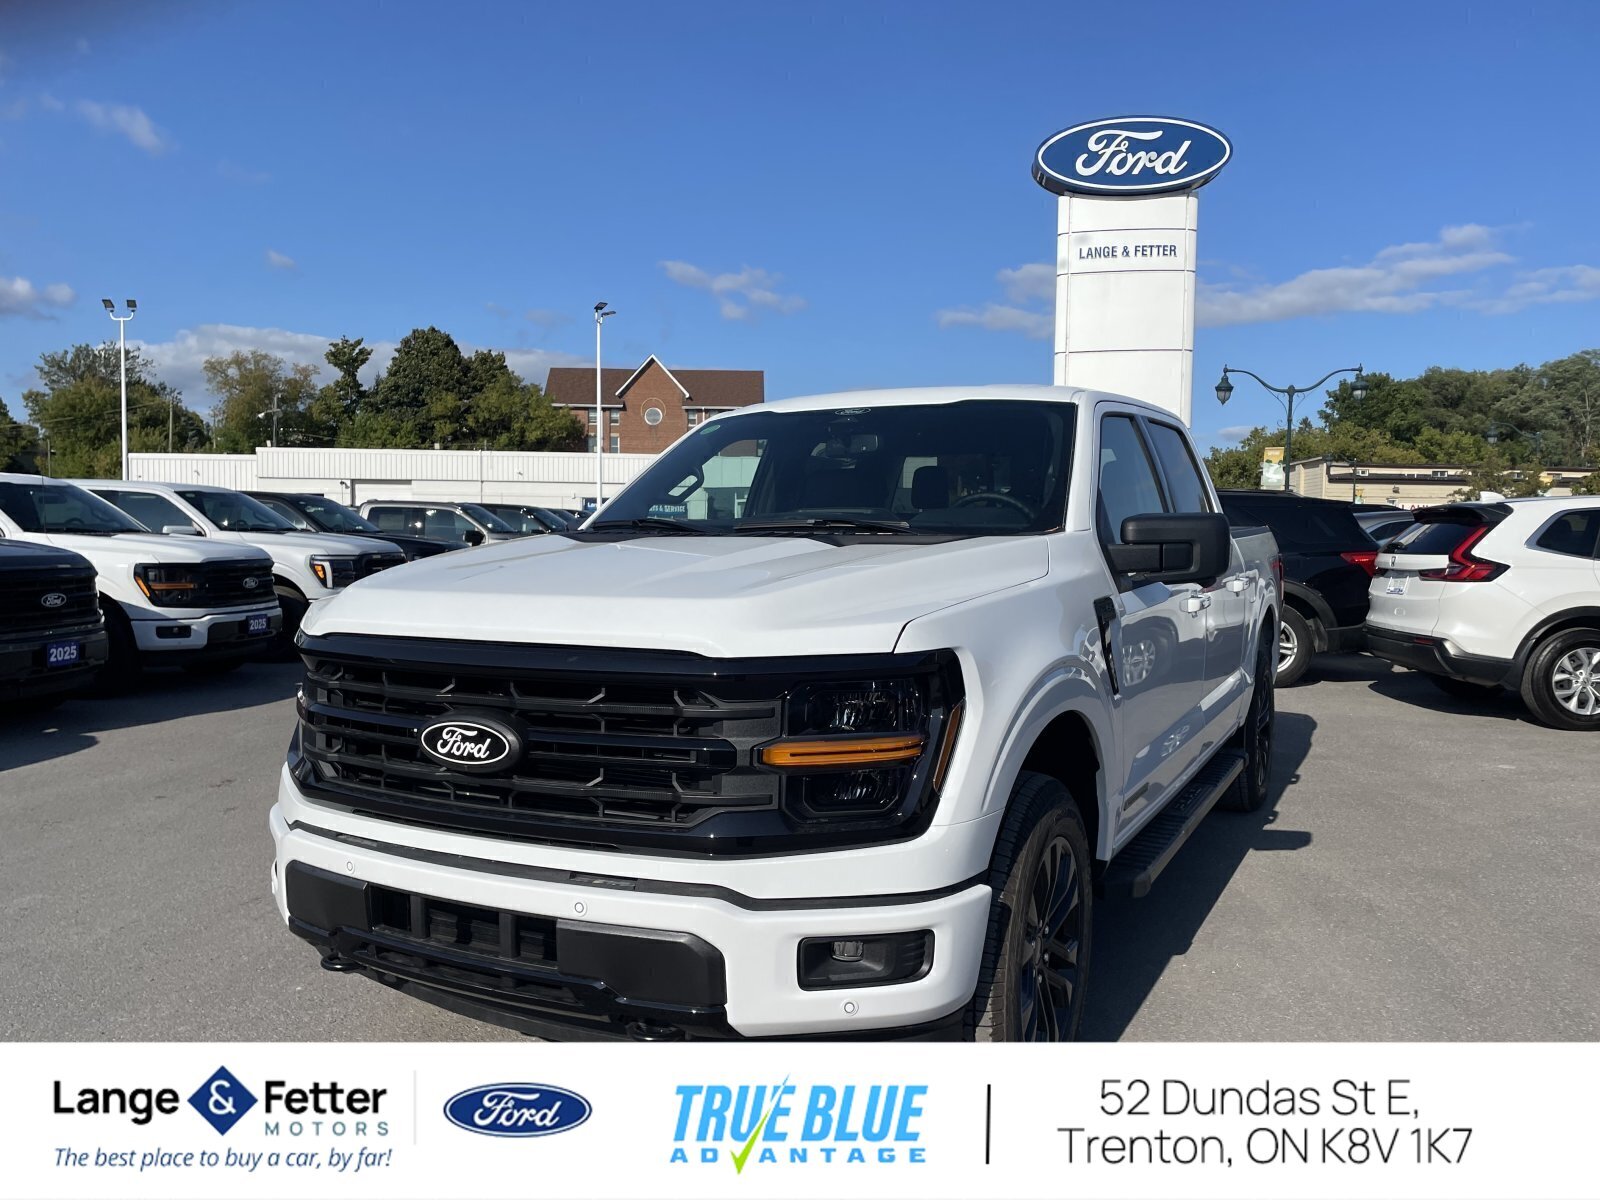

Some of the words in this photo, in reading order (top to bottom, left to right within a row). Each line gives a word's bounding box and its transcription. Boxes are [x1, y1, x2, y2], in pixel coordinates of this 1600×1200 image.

[1075, 129, 1192, 176] Ford
[1079, 246, 1118, 260] LANGE
[1121, 245, 1131, 258] &
[1134, 244, 1178, 258] FETTER
[249, 618, 267, 631] 2025
[49, 645, 77, 662] 2025
[436, 726, 491, 758] Ford
